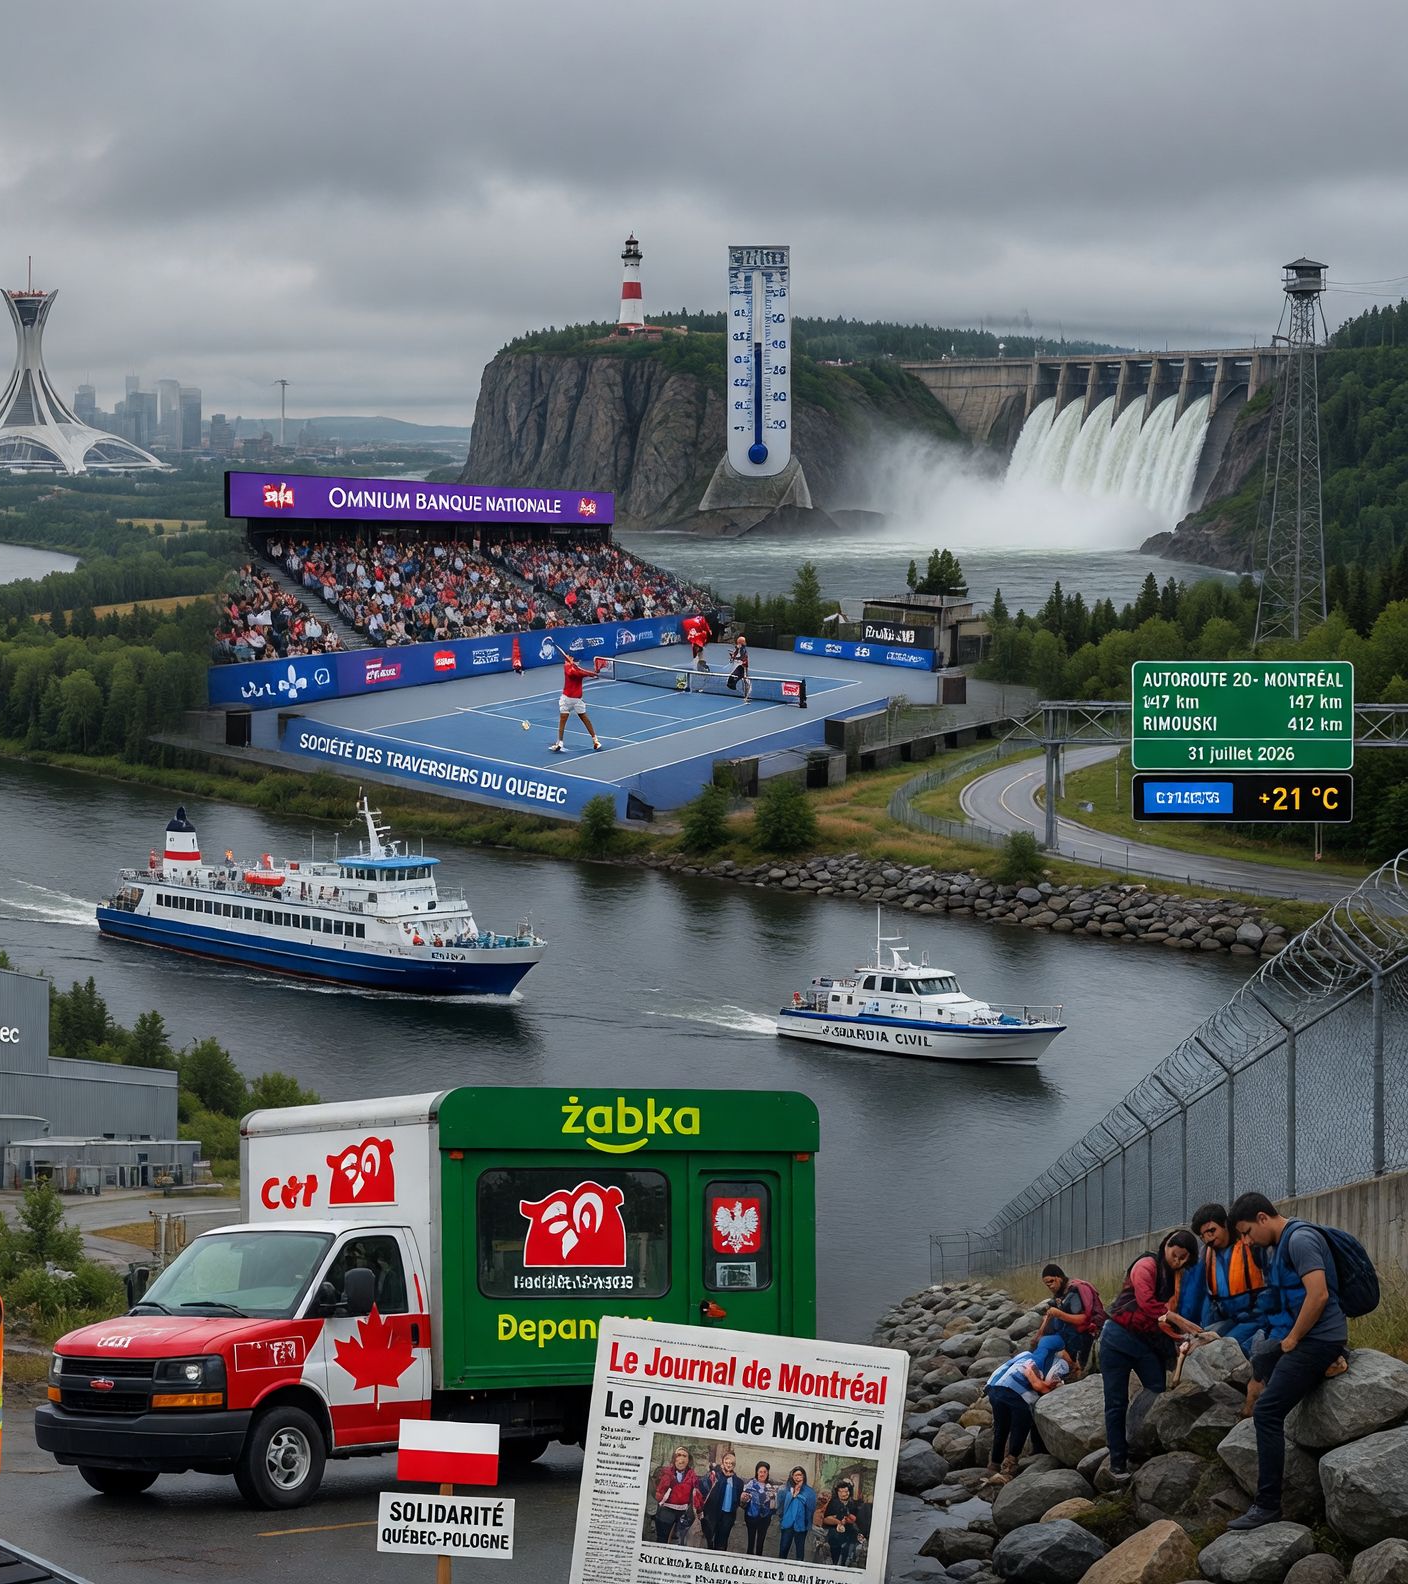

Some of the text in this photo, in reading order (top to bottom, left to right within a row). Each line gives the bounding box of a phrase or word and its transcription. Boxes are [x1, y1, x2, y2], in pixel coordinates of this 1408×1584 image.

[329, 487, 411, 510] OMNIUM
[416, 493, 482, 512] BANQUE
[486, 496, 562, 514] NATIONALE
[1143, 672, 1228, 688] AUTOROUTE
[1264, 669, 1344, 688] MONTRÉAL
[1176, 694, 1200, 709] km
[1289, 694, 1343, 709] 147 km
[1143, 716, 1217, 731] RIMOUSKI
[1287, 716, 1343, 731] 412 km
[1188, 746, 1295, 764] 31 juillet 2026
[300, 733, 568, 804] SOCIÉTÉ DES TRAVERSIERS DU QUEBEC
[1258, 787, 1339, 811] +21 °C
[895, 1033, 933, 1047] CIVIL
[561, 1096, 700, 1135] żabka
[609, 1341, 639, 1374] Le
[644, 1347, 737, 1387] Journal
[742, 1359, 772, 1391] de
[778, 1363, 888, 1405] Montréal
[604, 1391, 883, 1451] Le Journal de Montréal
[389, 1501, 505, 1527] SOLIDARITÉ
[382, 1525, 509, 1550] QUÉBEC-POLOGNE
